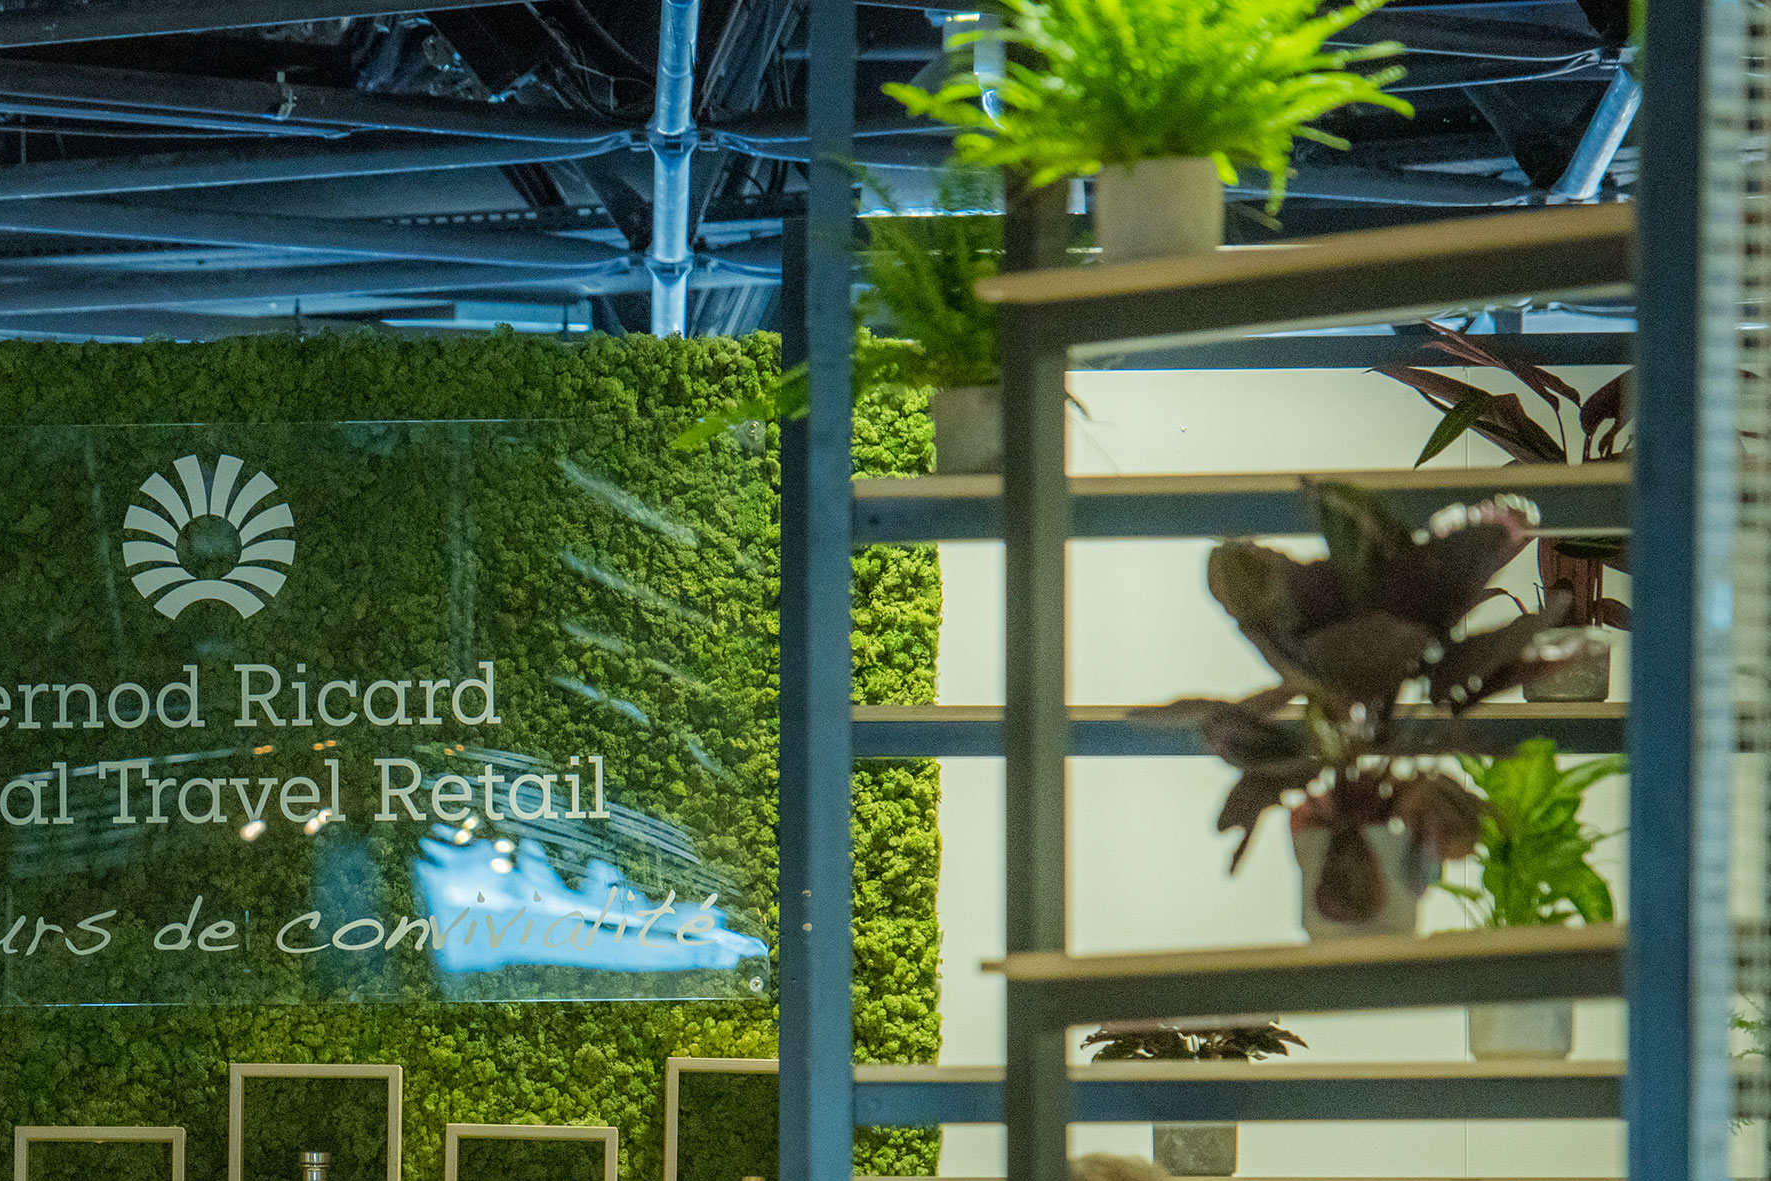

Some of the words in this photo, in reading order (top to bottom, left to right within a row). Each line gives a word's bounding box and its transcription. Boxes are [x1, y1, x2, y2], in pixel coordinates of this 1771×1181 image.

[233, 660, 502, 727] Ricard
[98, 759, 346, 824] Travel
[373, 755, 611, 821] Retail
[153, 894, 239, 951] de
[276, 886, 719, 954] convivialité
